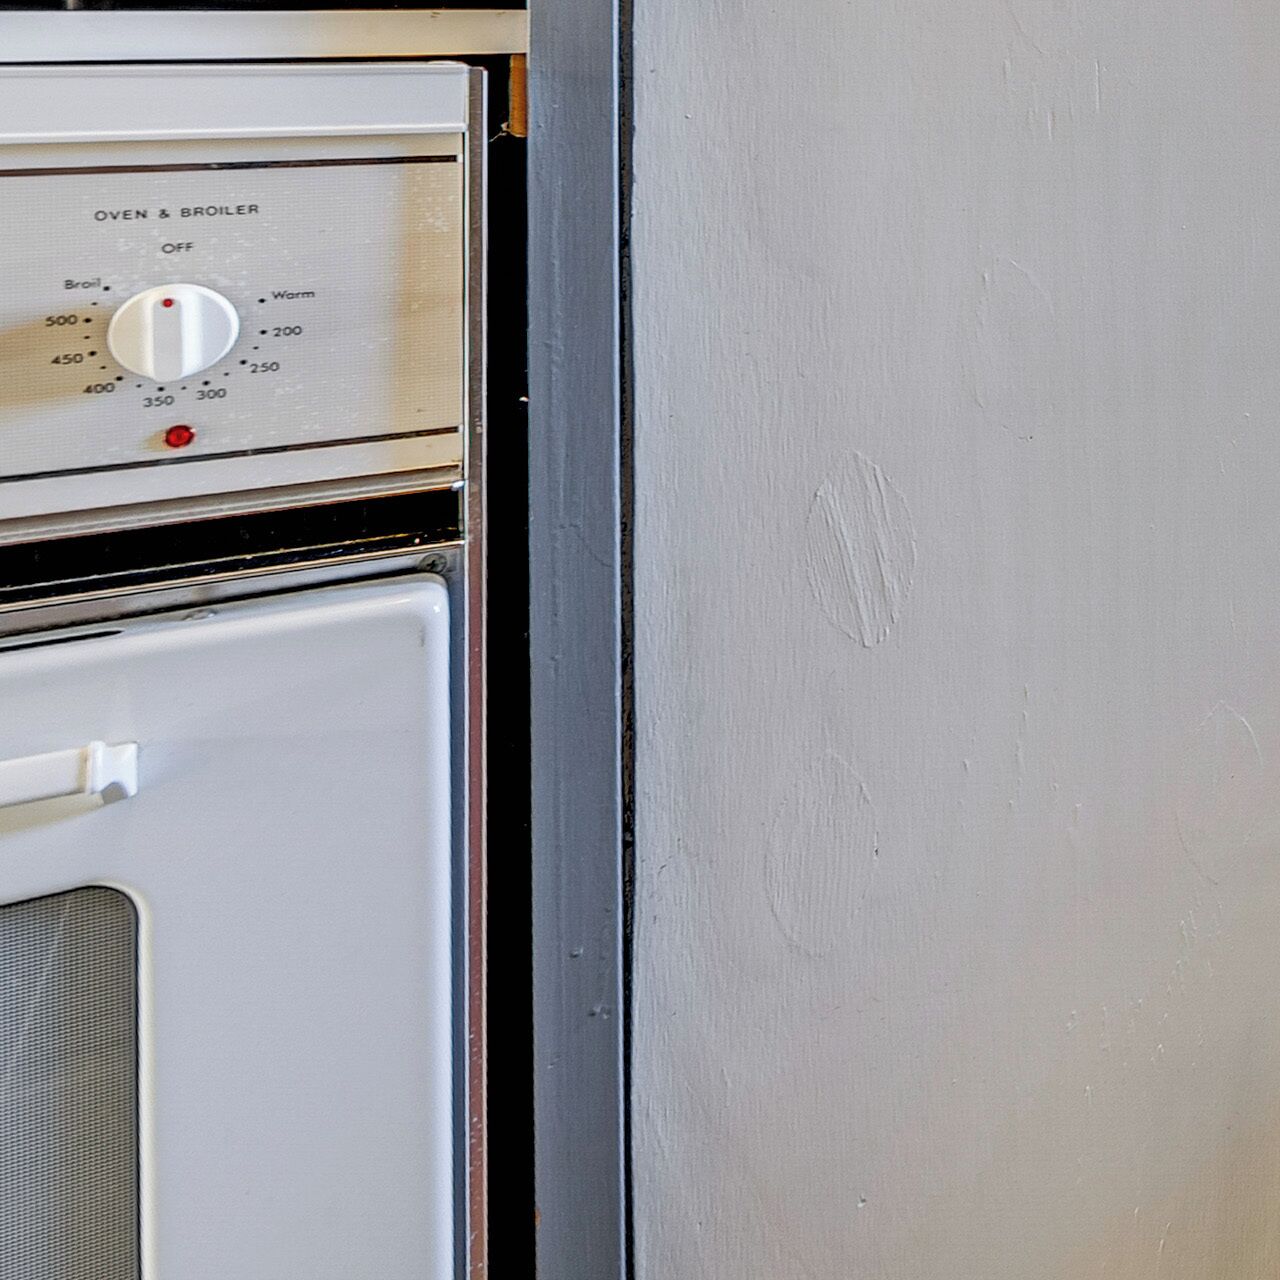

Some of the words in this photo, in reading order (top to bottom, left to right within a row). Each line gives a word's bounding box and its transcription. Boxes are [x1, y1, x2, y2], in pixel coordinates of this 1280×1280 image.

[94, 208, 148, 222] OVEN
[158, 208, 171, 220] &
[180, 203, 260, 219] BROILER
[161, 241, 195, 255] OFF
[64, 277, 102, 291] Broil
[271, 289, 316, 301] Warm
[45, 313, 78, 328] 500
[272, 325, 304, 338] 200
[51, 352, 84, 366] 450
[250, 361, 281, 375] 250
[83, 381, 116, 396] 400
[196, 387, 227, 402] 300
[143, 394, 175, 409] 350
